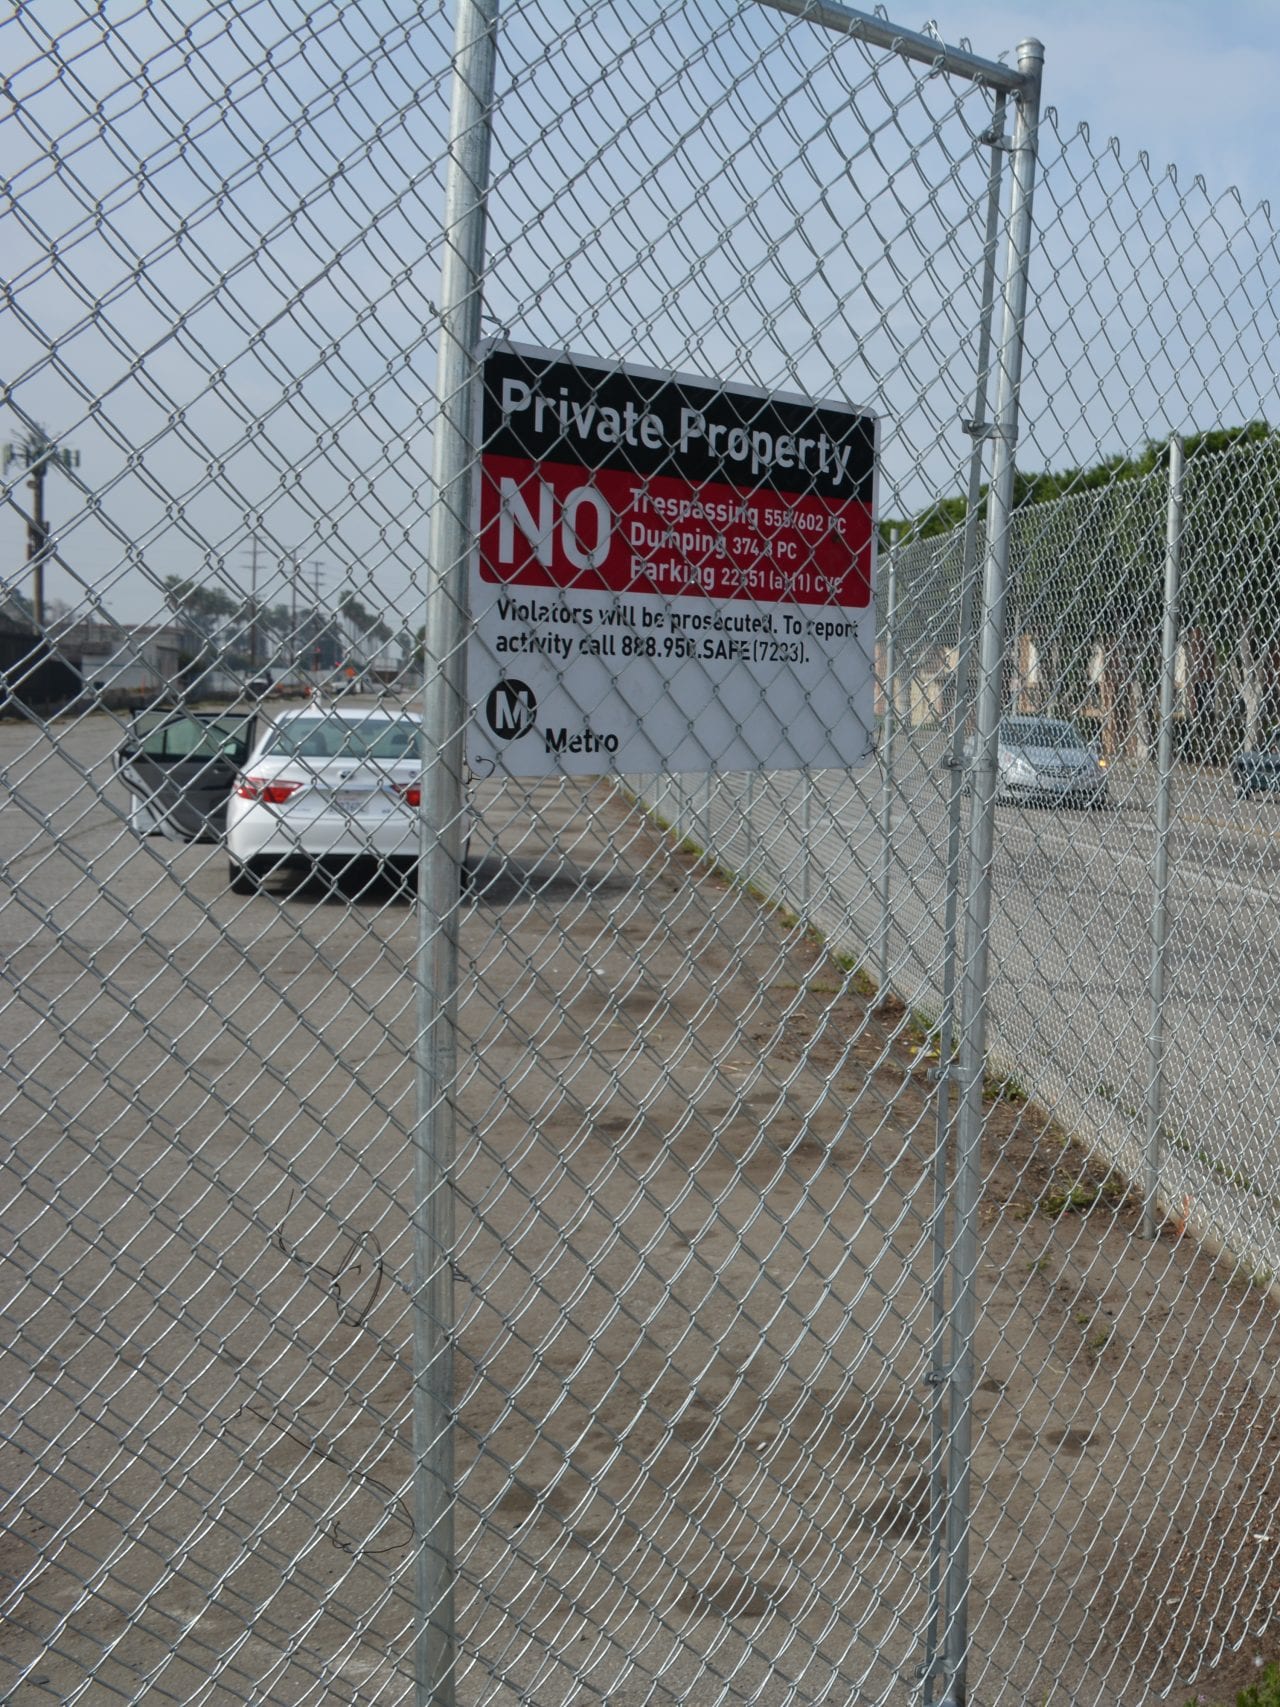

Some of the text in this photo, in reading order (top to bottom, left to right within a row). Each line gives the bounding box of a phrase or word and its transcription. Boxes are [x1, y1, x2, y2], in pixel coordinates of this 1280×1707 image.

[502, 377, 852, 486] Private Property
[499, 477, 611, 570] NO
[629, 487, 759, 531] Trespassing
[631, 521, 727, 559] Dumping
[777, 541, 797, 560] PC
[630, 555, 715, 591] Parking
[497, 599, 859, 641] Violators will be prosecuted. To report
[496, 632, 574, 659] activity
[579, 634, 616, 656] call
[495, 690, 529, 729] M
[545, 728, 619, 753] Metro
